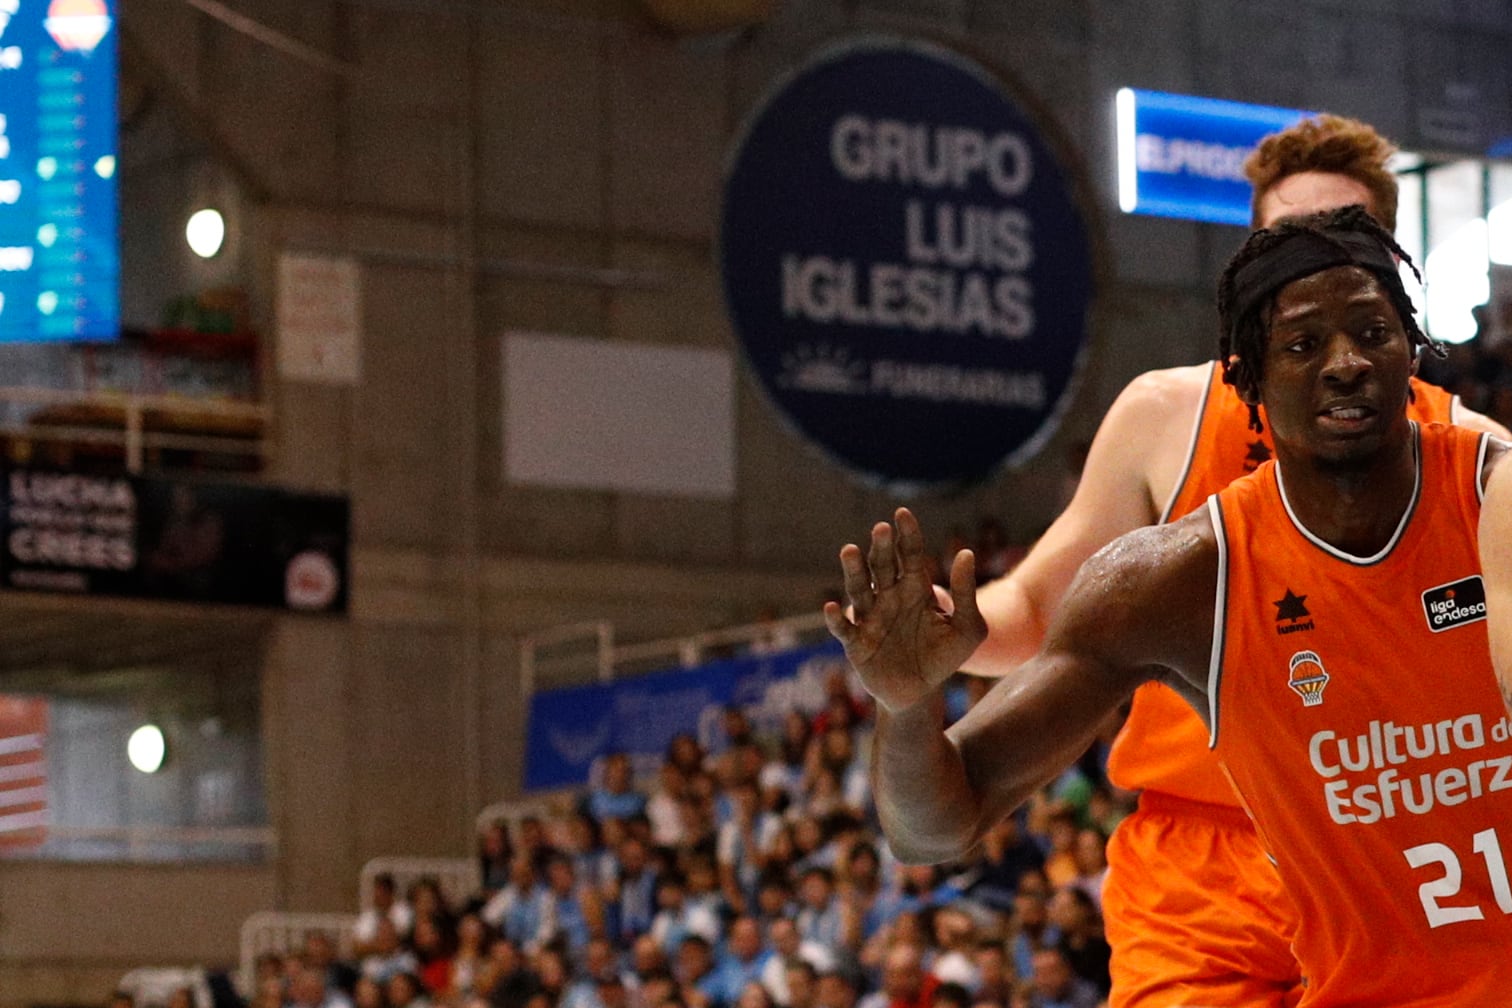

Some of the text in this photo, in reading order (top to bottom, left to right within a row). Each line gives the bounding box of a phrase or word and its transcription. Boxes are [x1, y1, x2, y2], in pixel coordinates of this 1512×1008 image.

[829, 113, 1035, 196] GRUPO
[905, 200, 1034, 272] LUIS
[780, 255, 1036, 340] IGLESIAS
[1430, 599, 1455, 614] liga
[1434, 602, 1486, 625] endesa
[1309, 714, 1485, 778] Cultura
